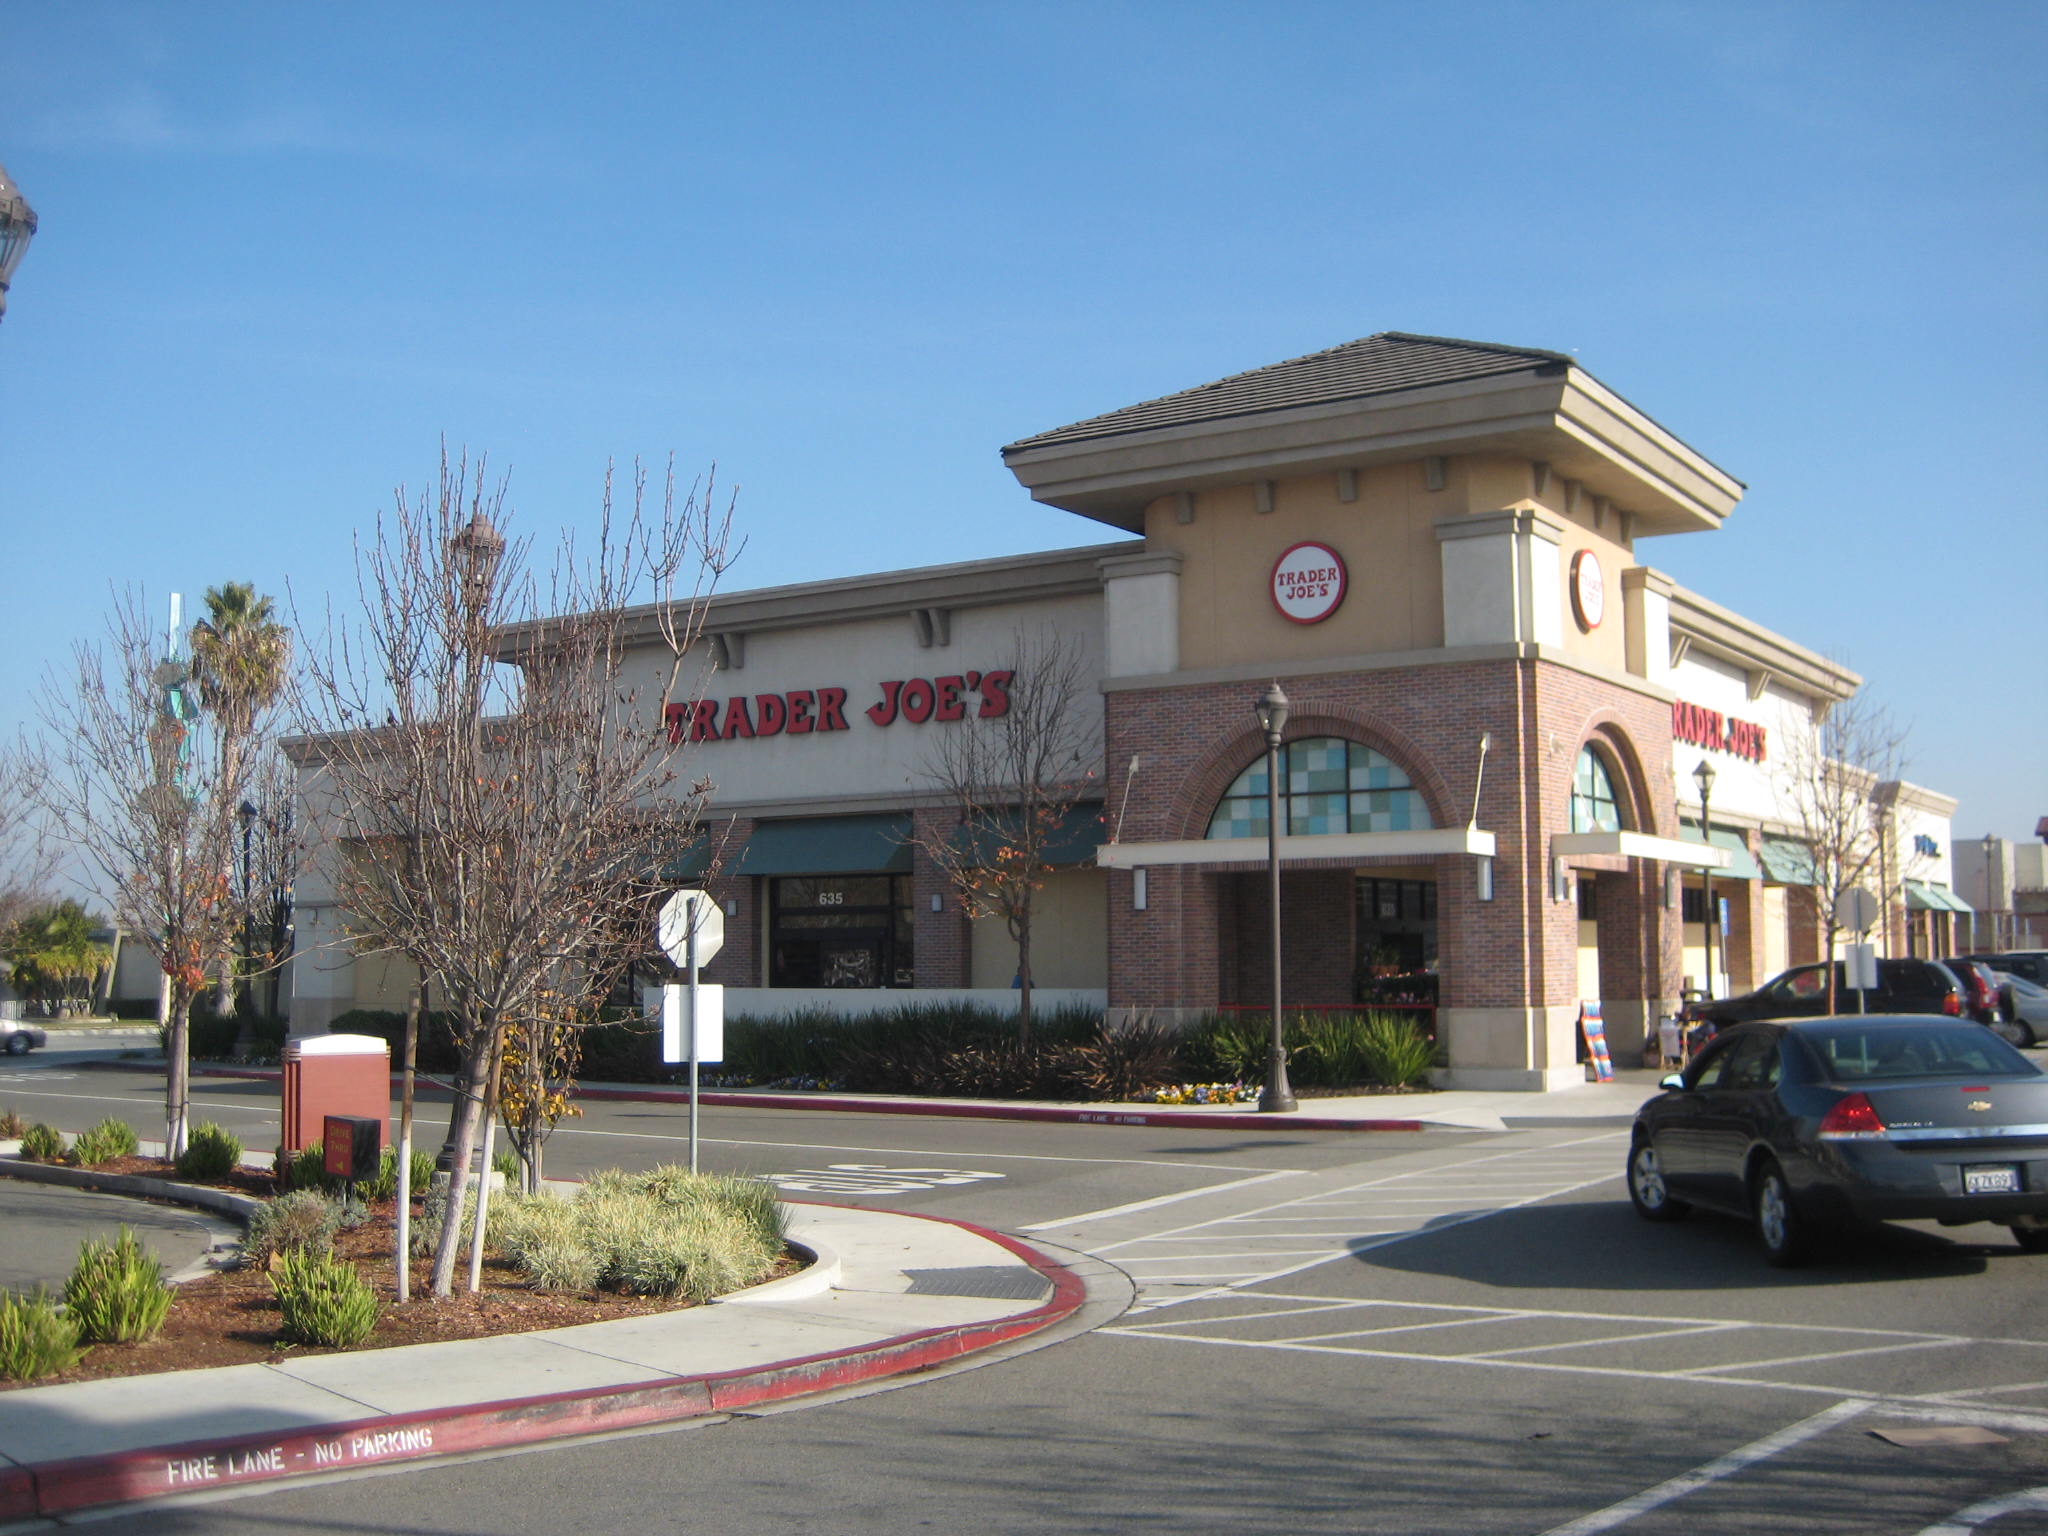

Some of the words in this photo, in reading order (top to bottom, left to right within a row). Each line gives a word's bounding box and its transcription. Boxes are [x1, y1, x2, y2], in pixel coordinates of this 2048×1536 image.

[1278, 567, 1337, 586] TRADER
[1286, 584, 1329, 600] JOE'S
[664, 687, 850, 745] TRADER
[865, 670, 1015, 727] JOE'S
[1674, 698, 1725, 750] RADER
[818, 892, 844, 905] 635
[167, 1456, 219, 1484] FIRE
[228, 1447, 286, 1476] LANE
[314, 1442, 343, 1463] NO
[351, 1428, 433, 1458] PARKING
